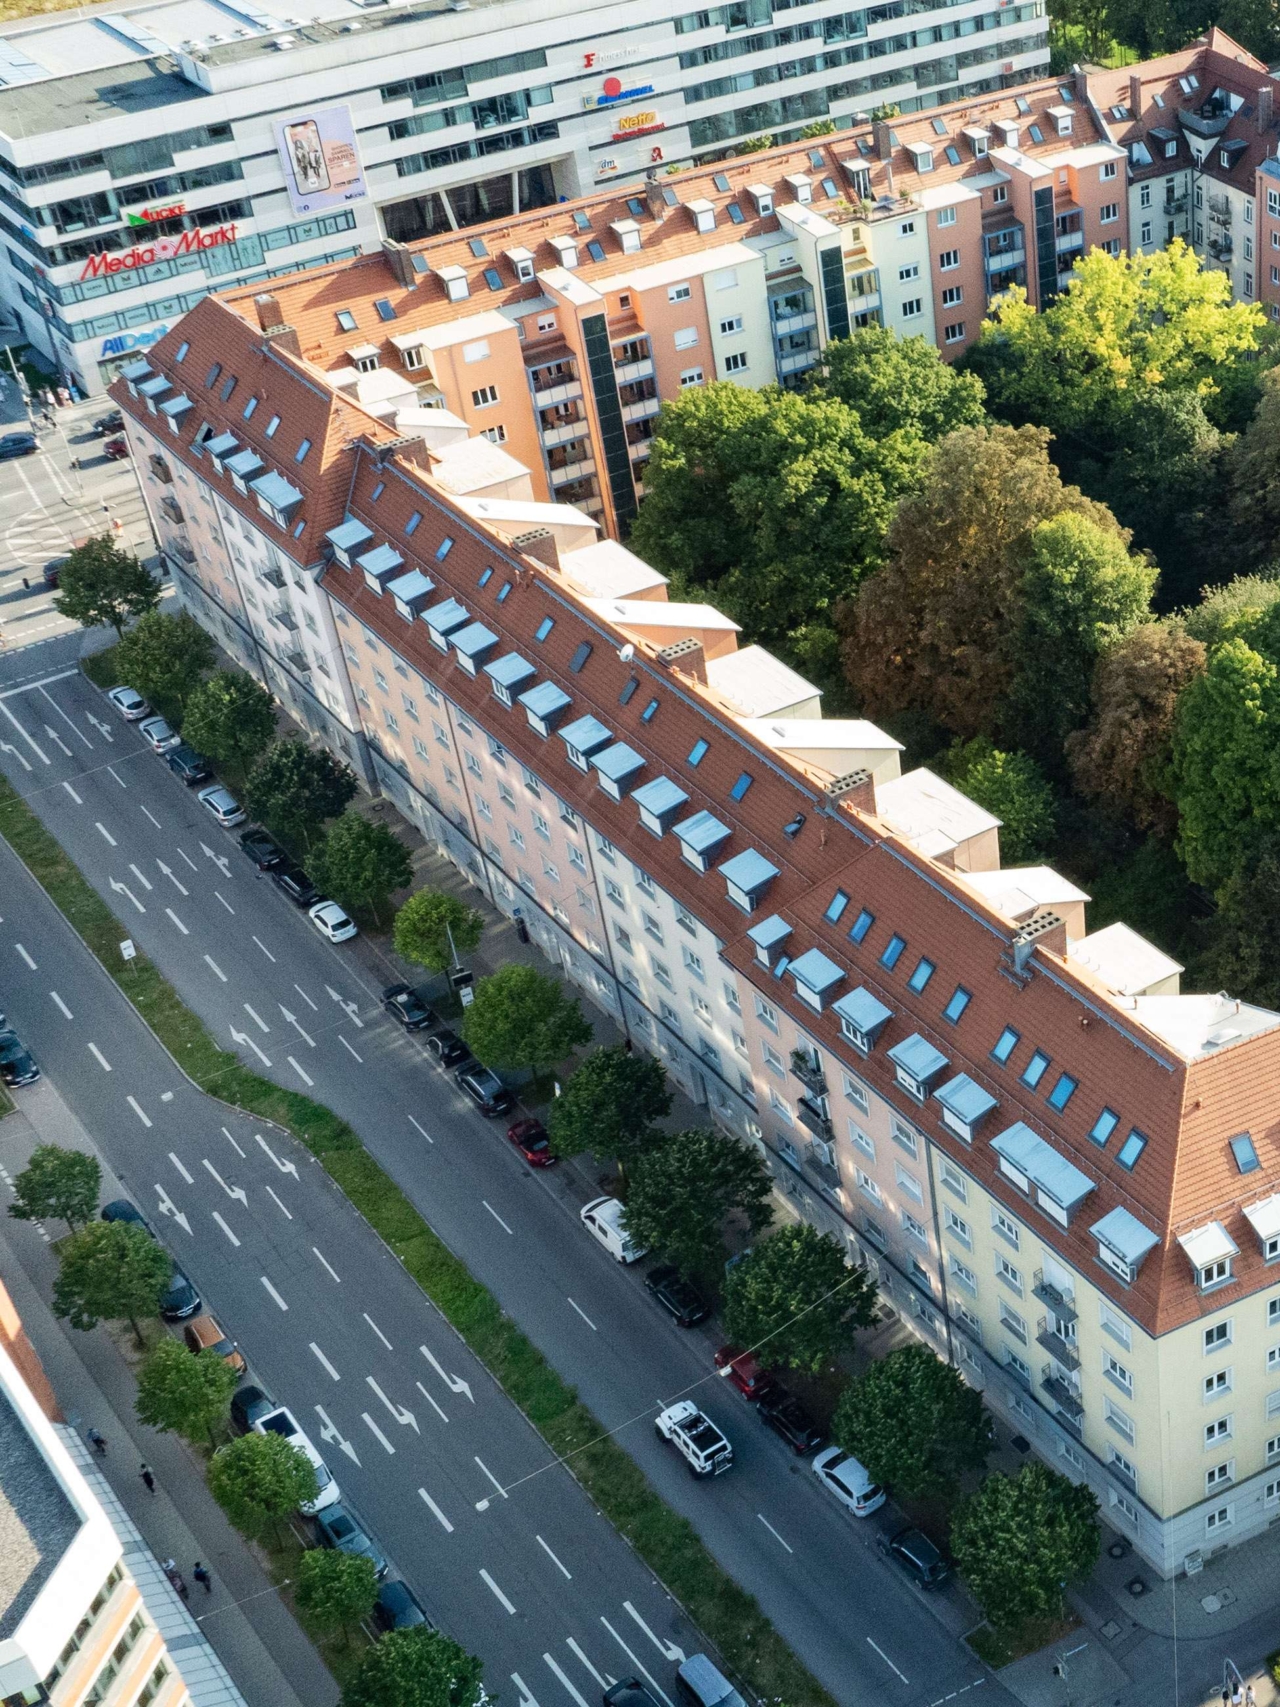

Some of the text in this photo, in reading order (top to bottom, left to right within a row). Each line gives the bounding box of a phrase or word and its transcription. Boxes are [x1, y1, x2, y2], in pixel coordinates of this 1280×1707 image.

[619, 111, 656, 130] Netto
[328, 152, 355, 163] SPAREN
[601, 159, 615, 169] dm
[80, 223, 238, 281] Media Markt
